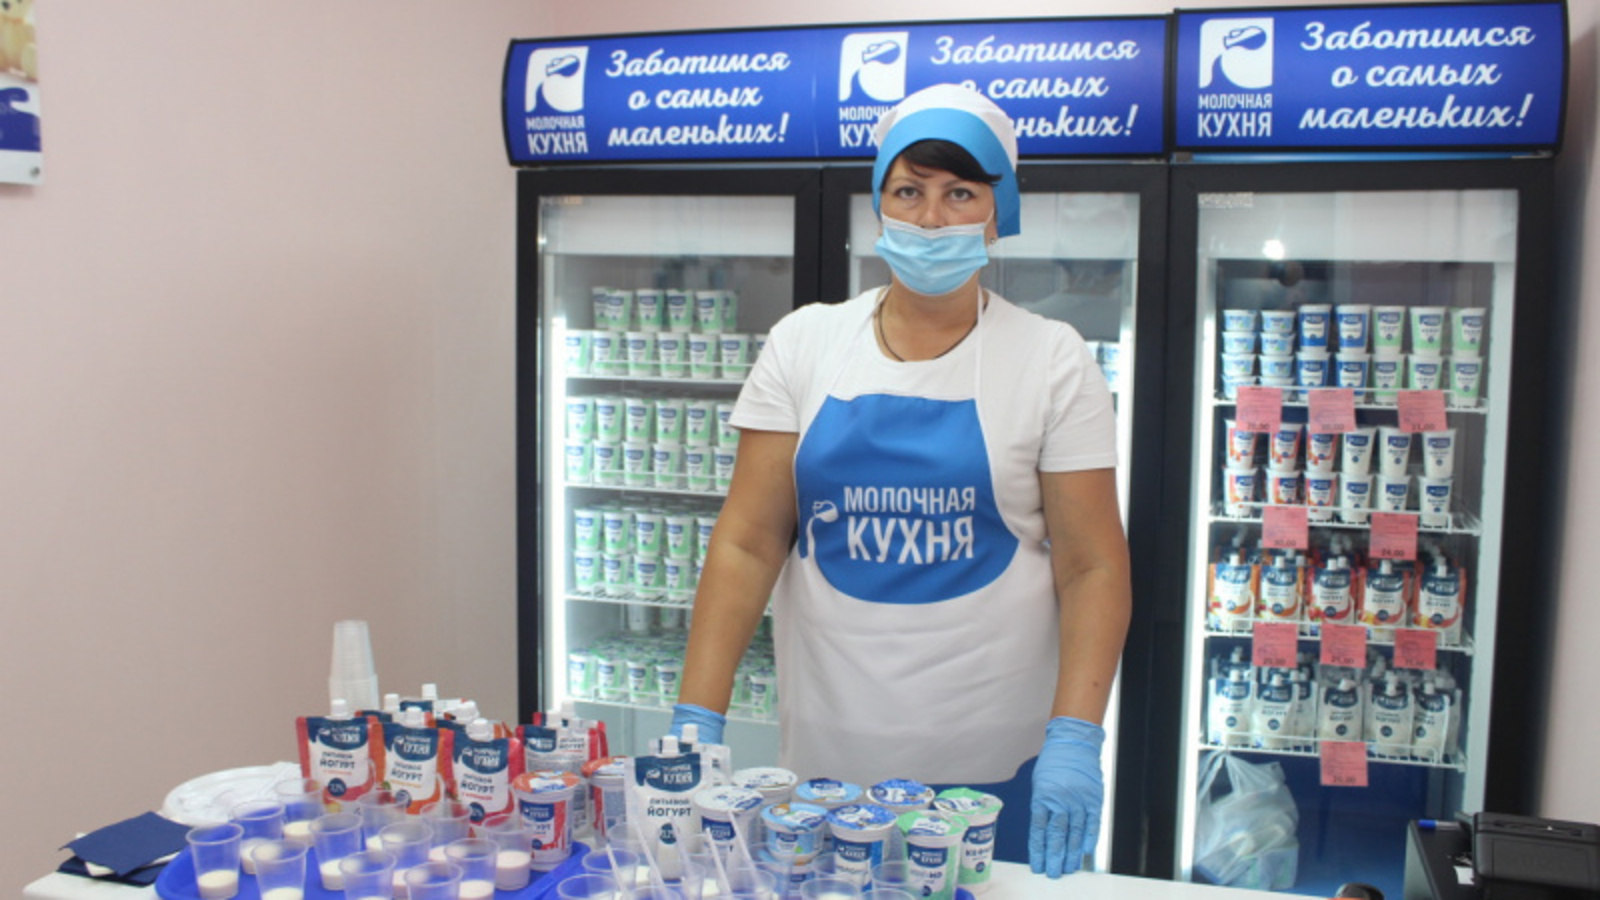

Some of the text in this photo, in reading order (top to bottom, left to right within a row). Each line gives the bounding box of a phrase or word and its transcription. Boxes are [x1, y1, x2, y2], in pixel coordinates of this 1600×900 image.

[1300, 21, 1536, 51] Заботимся
[605, 48, 791, 77] Заботимся
[930, 35, 1140, 64] Заботимся
[987, 76, 1109, 99] самых
[1331, 62, 1502, 88] о самых
[628, 87, 763, 111] о самых
[1198, 93, 1273, 109] МОЛОЧНАЯ
[1299, 93, 1534, 129] маленьких!
[526, 115, 585, 130] МОЛОЧНАЯ
[607, 112, 790, 146] маленьких!
[1014, 104, 1140, 138] ньких!
[1197, 112, 1272, 138] КУХНЯ
[527, 131, 588, 154] КУХНЯ
[840, 123, 880, 147] КУХ
[843, 486, 975, 514] МОЛОЧНАЯ
[847, 516, 974, 564] КУХНЯ
[647, 805, 692, 817] ЙОГУРТ
